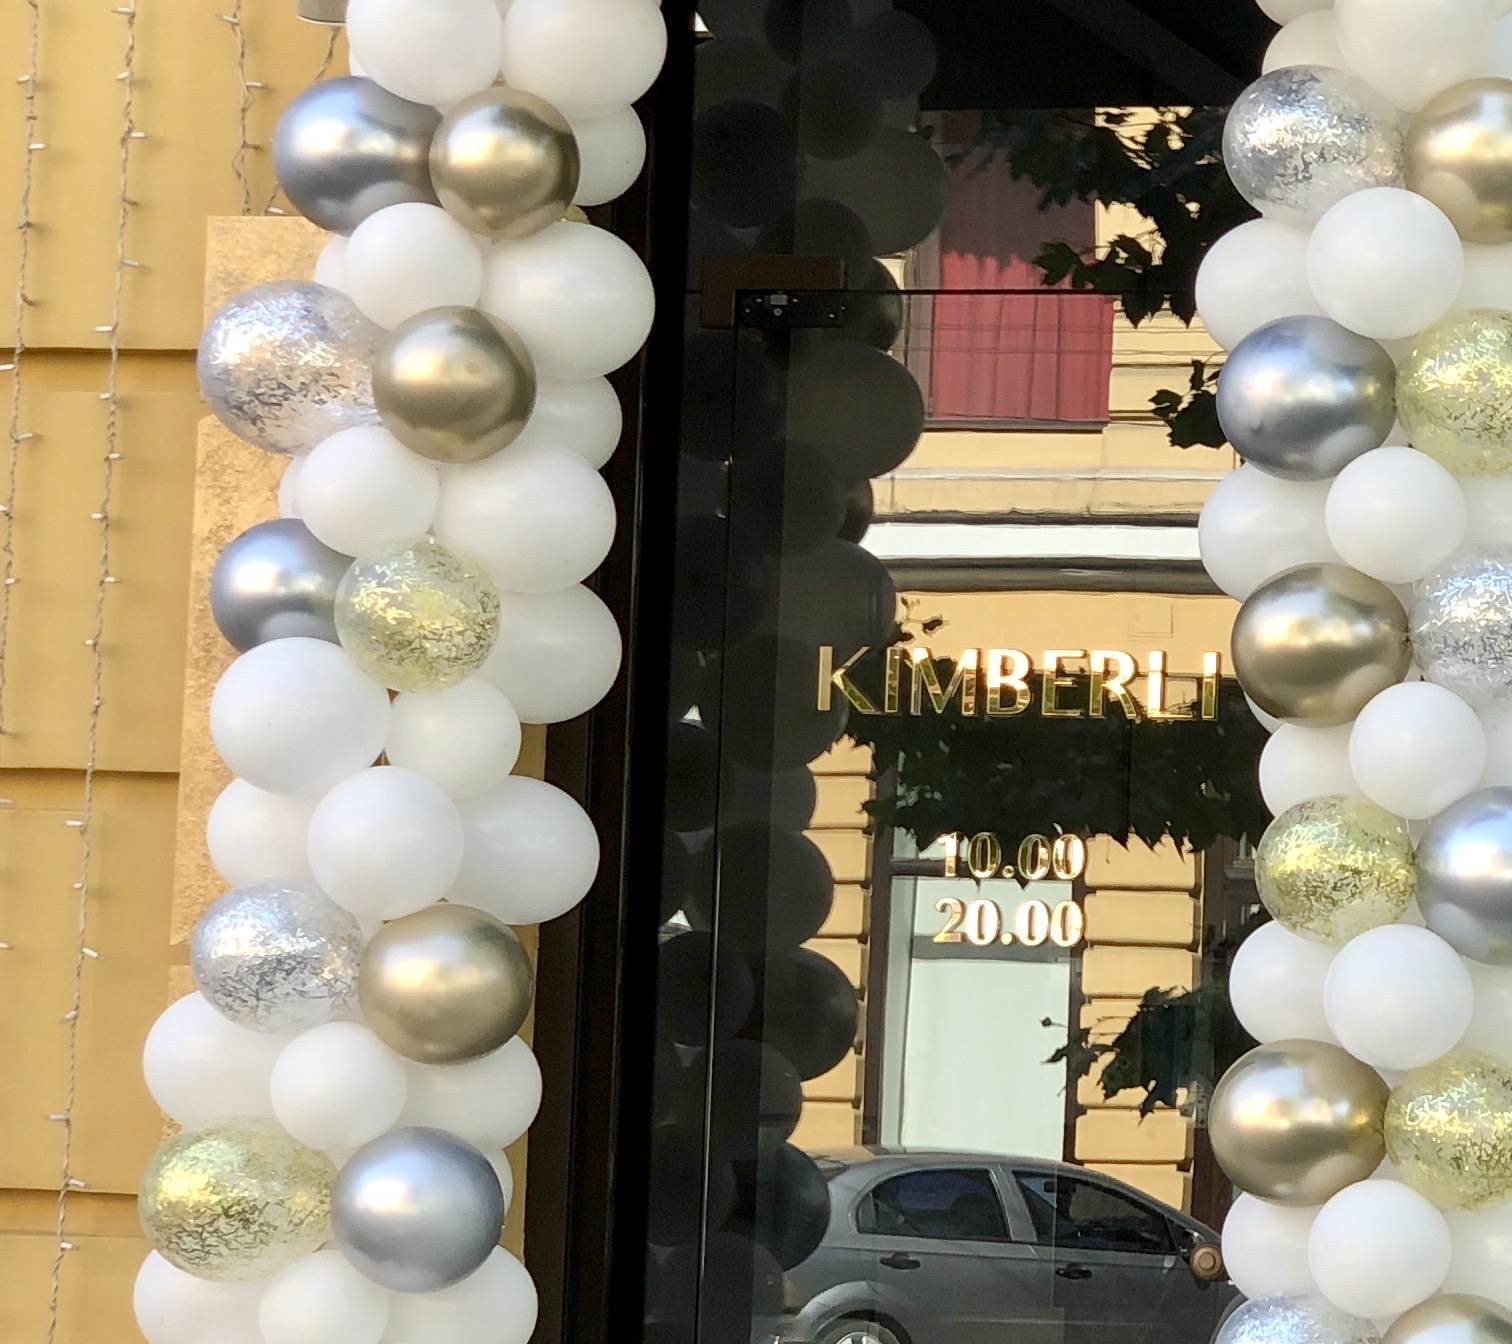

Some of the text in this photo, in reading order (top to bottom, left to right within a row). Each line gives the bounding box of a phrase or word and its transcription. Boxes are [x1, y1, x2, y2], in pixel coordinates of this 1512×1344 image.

[815, 644, 1222, 722] KIMBERLI
[936, 831, 1087, 881] 10.00
[932, 896, 1086, 948] 20.00
